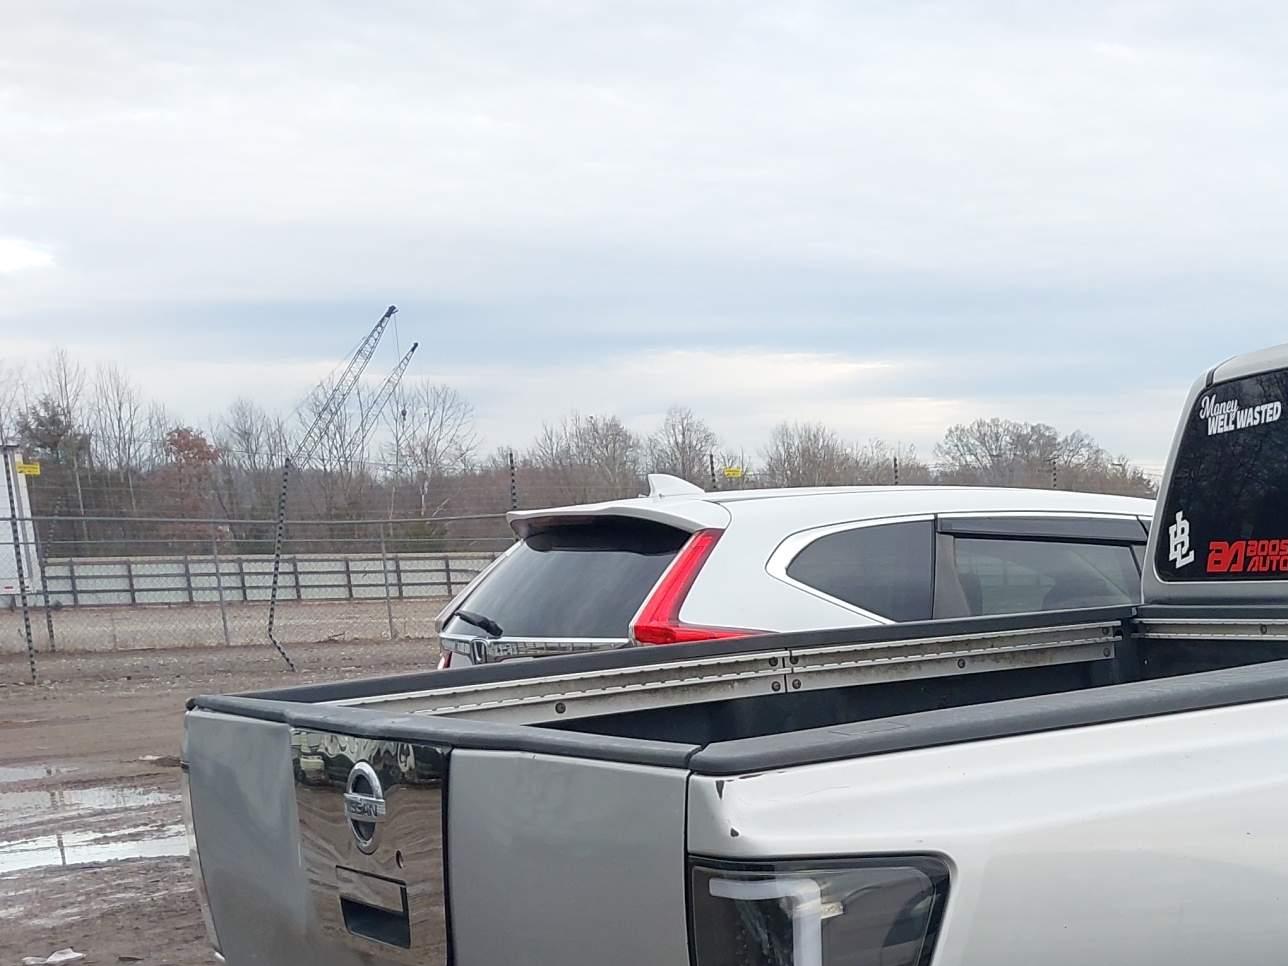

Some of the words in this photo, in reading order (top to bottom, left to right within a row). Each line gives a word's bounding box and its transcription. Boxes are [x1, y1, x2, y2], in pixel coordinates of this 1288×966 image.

[1200, 394, 1239, 421] Money
[1207, 413, 1235, 436] WELL
[1236, 401, 1282, 429] WASTED
